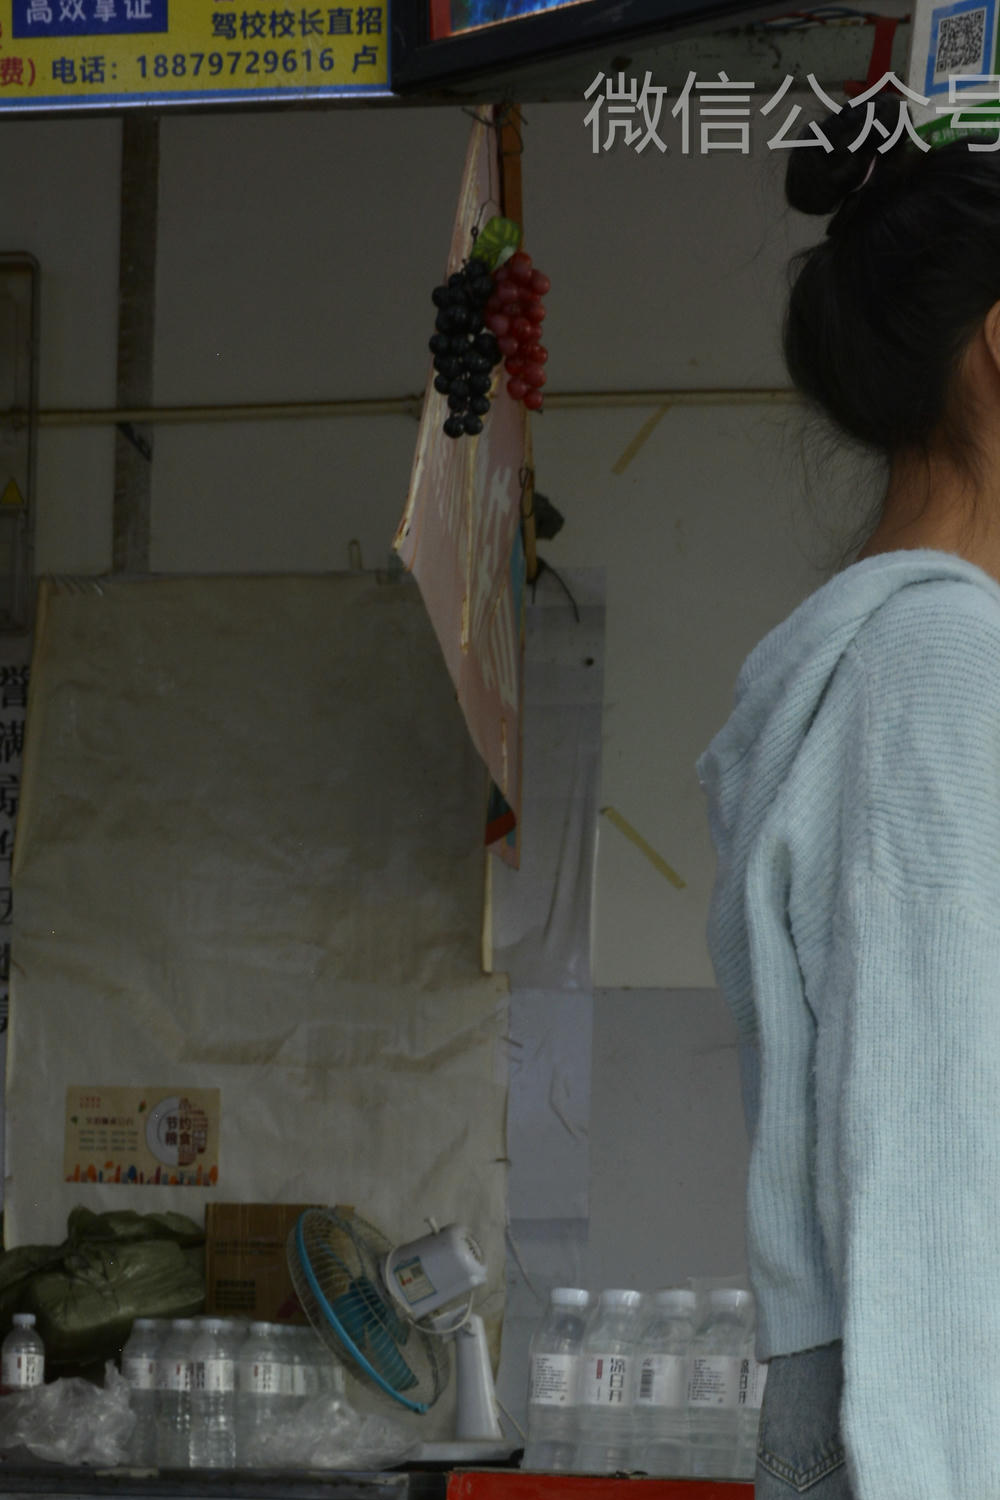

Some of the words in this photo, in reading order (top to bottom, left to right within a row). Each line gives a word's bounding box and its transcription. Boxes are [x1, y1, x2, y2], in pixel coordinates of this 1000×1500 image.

[211, 8, 383, 40] 驾校校长直招
[352, 45, 379, 73] 卢
